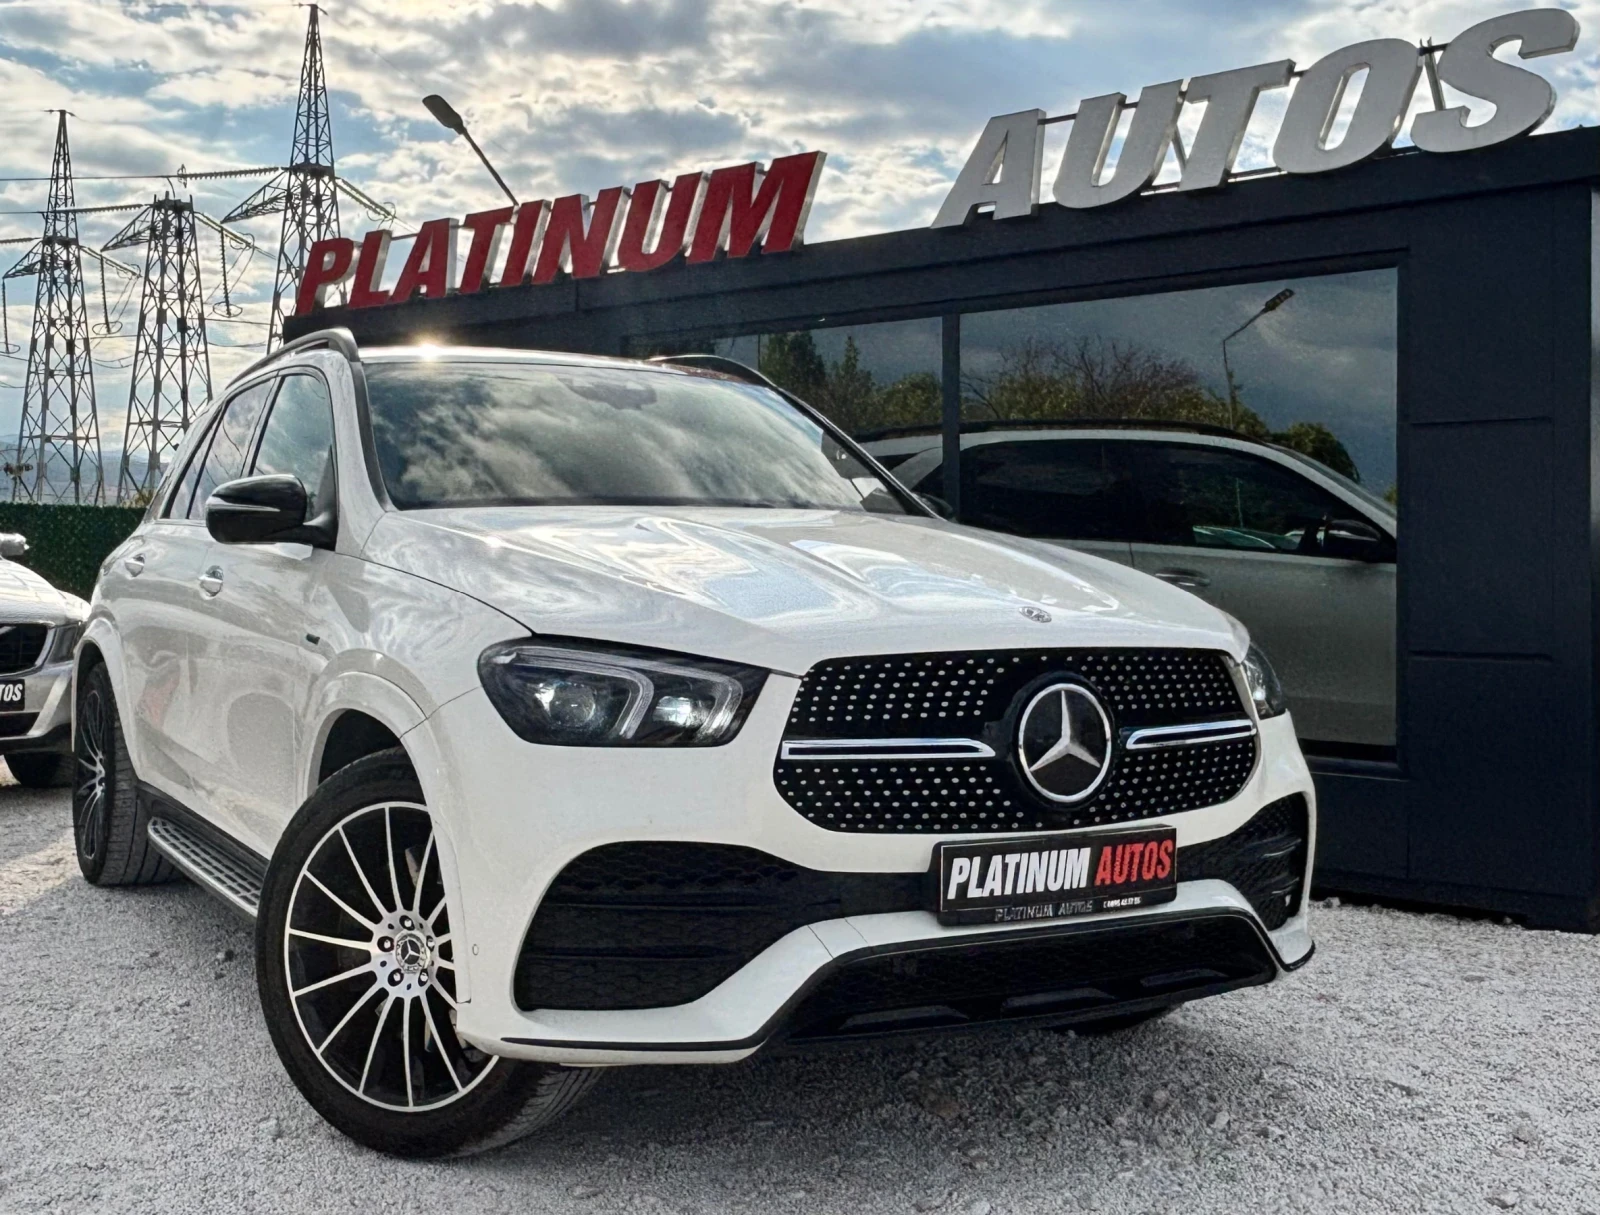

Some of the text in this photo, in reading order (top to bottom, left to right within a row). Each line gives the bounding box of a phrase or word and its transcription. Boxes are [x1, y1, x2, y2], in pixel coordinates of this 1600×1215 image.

[296, 8, 1580, 316] PLATINUM AUTOS
[947, 839, 1174, 900] PLATINUM AUTOS
[995, 903, 1053, 922] PLATINUM
[1058, 900, 1093, 916] AUTOS
